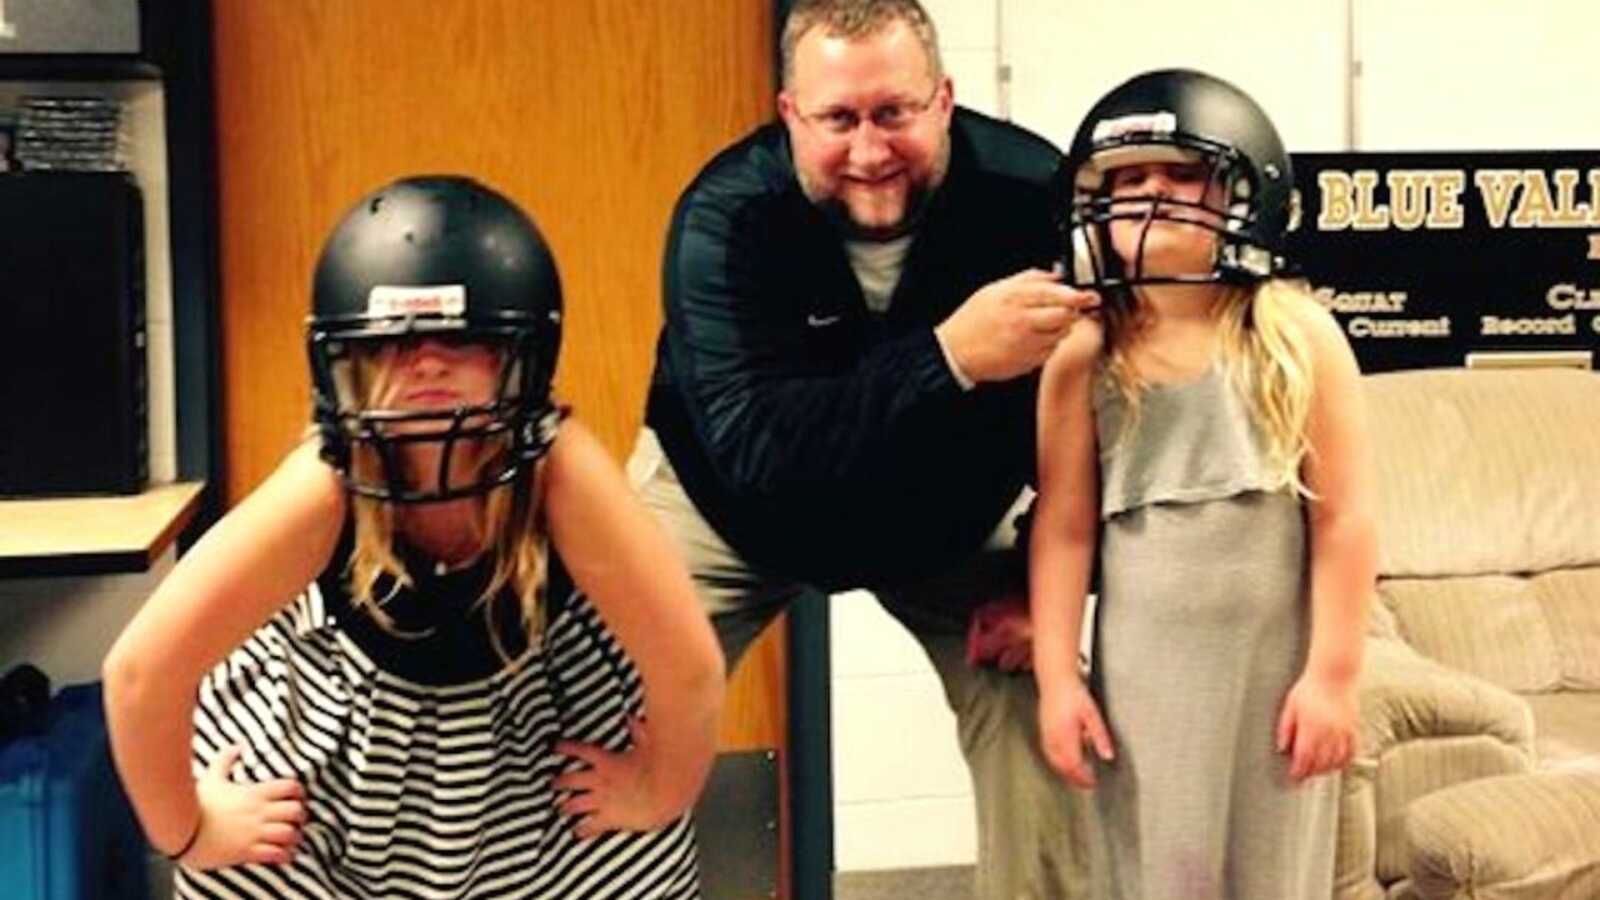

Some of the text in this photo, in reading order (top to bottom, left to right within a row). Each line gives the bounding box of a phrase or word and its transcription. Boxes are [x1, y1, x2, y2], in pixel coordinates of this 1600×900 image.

[1318, 170, 1465, 230] BLUE
[1349, 317, 1450, 338] Current
[1481, 315, 1576, 336] Record
